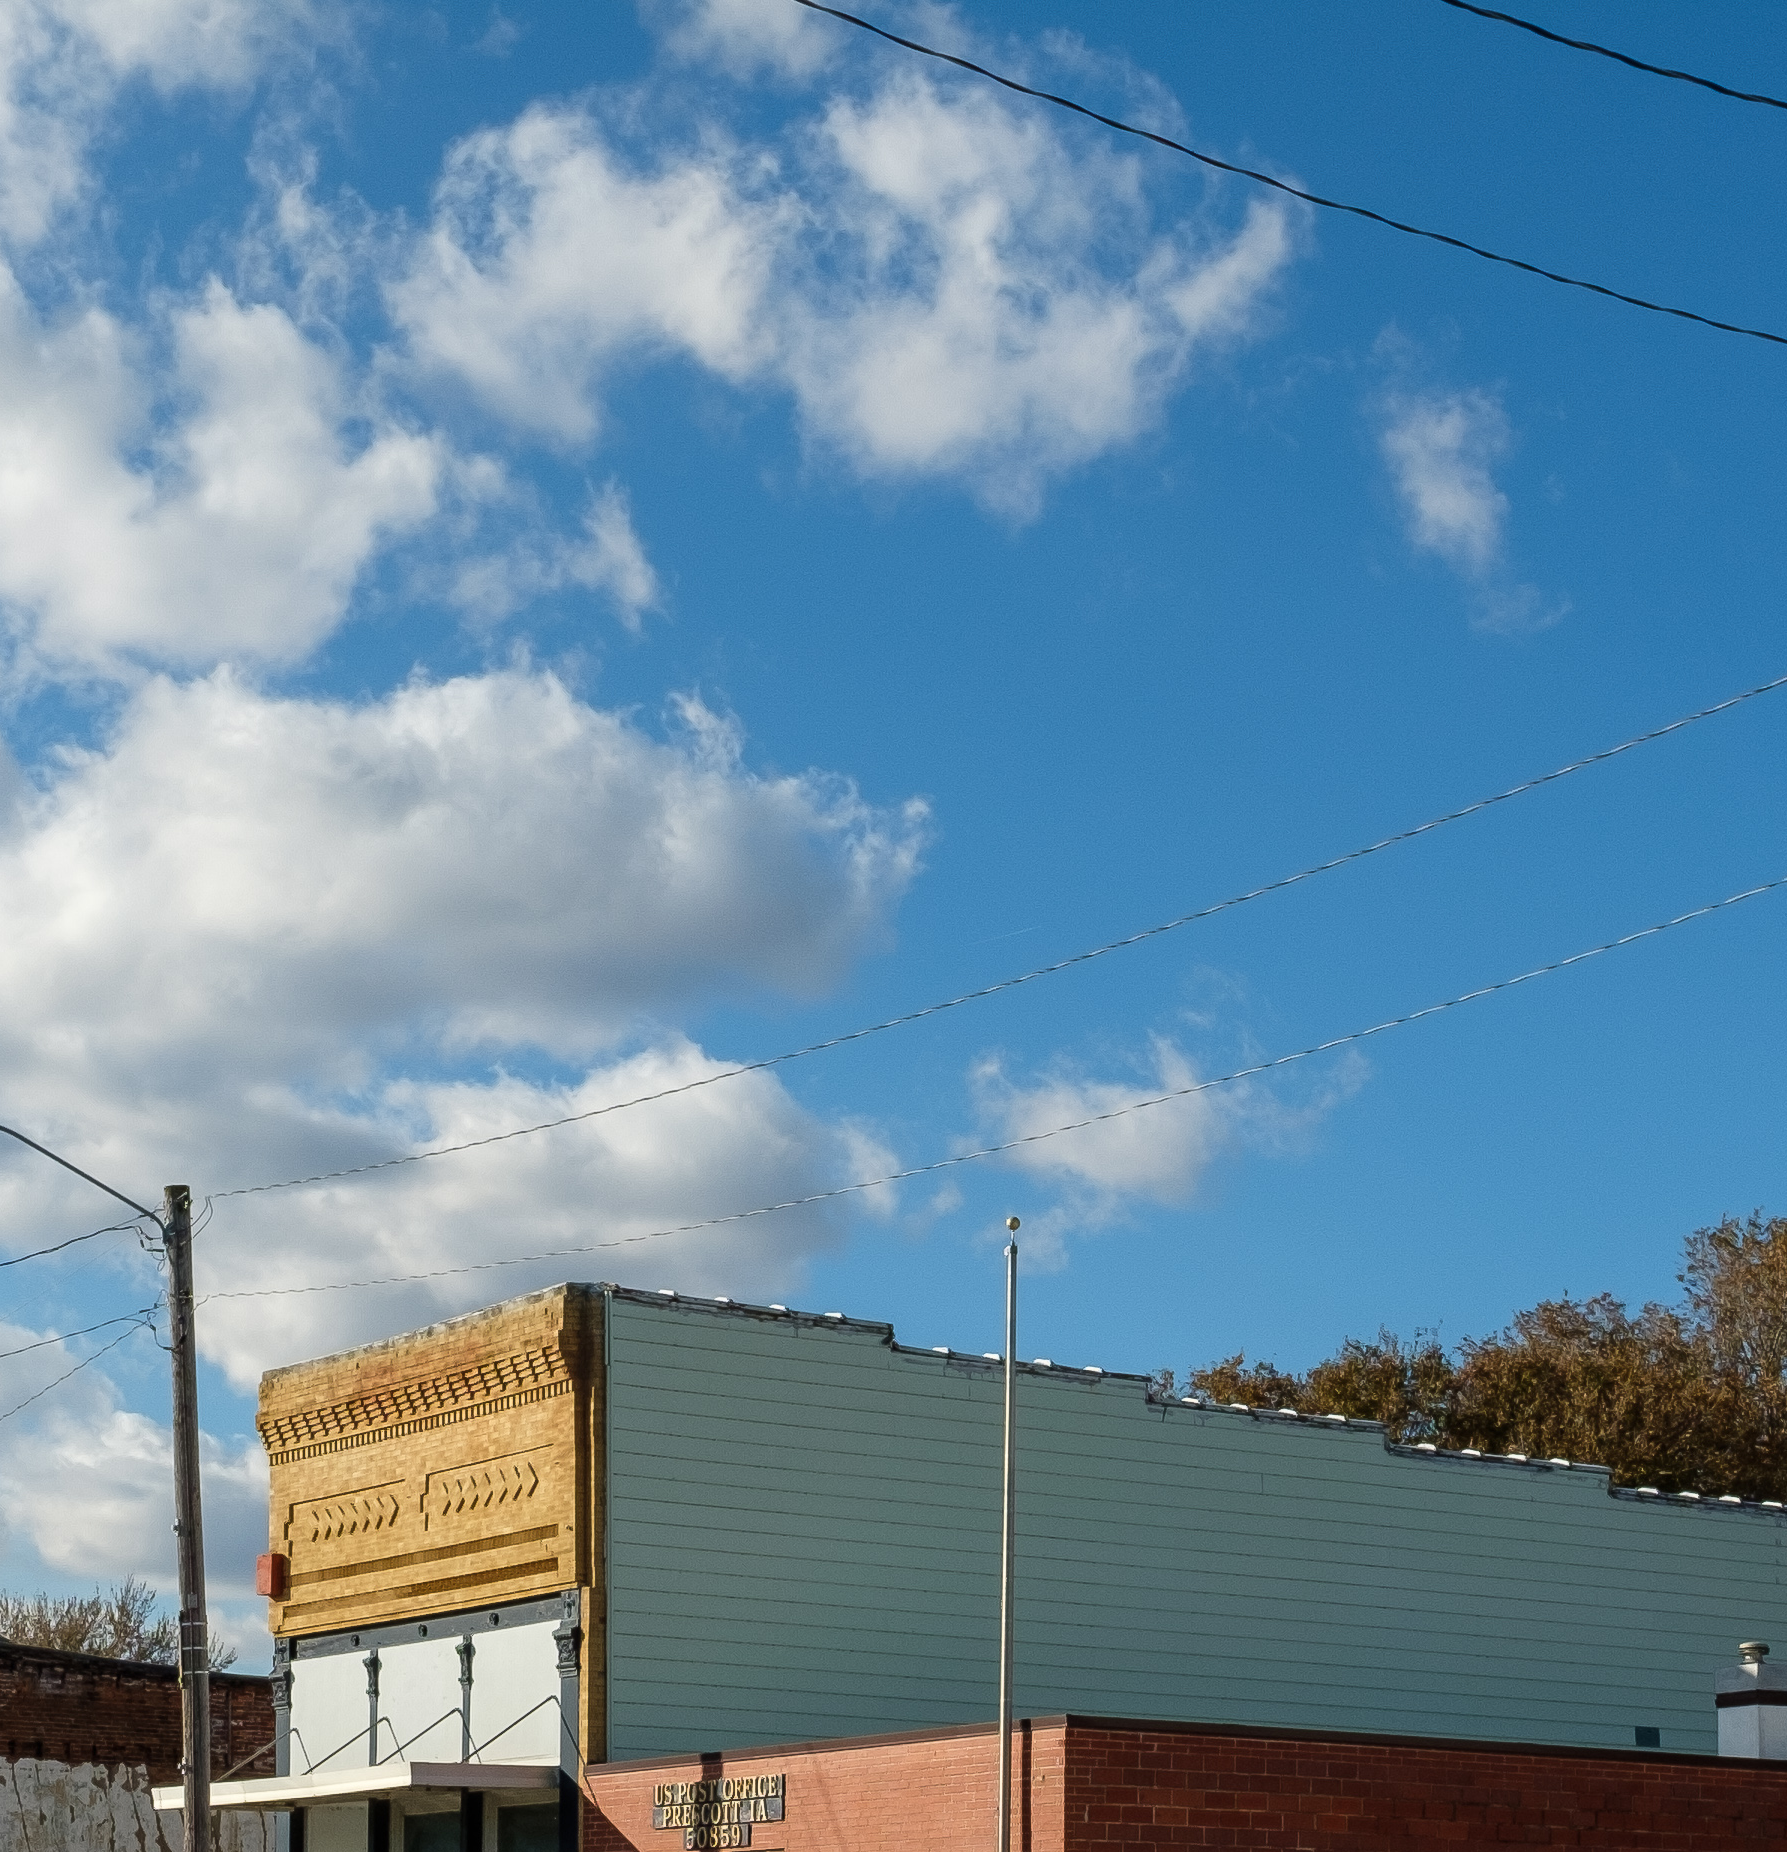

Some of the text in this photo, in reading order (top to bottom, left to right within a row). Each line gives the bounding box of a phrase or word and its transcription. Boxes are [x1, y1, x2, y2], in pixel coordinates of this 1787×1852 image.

[654, 1774, 778, 1805] US POST OFFICE
[662, 1799, 768, 1828] PRESCOTT IA
[686, 1825, 741, 1850] 50859
